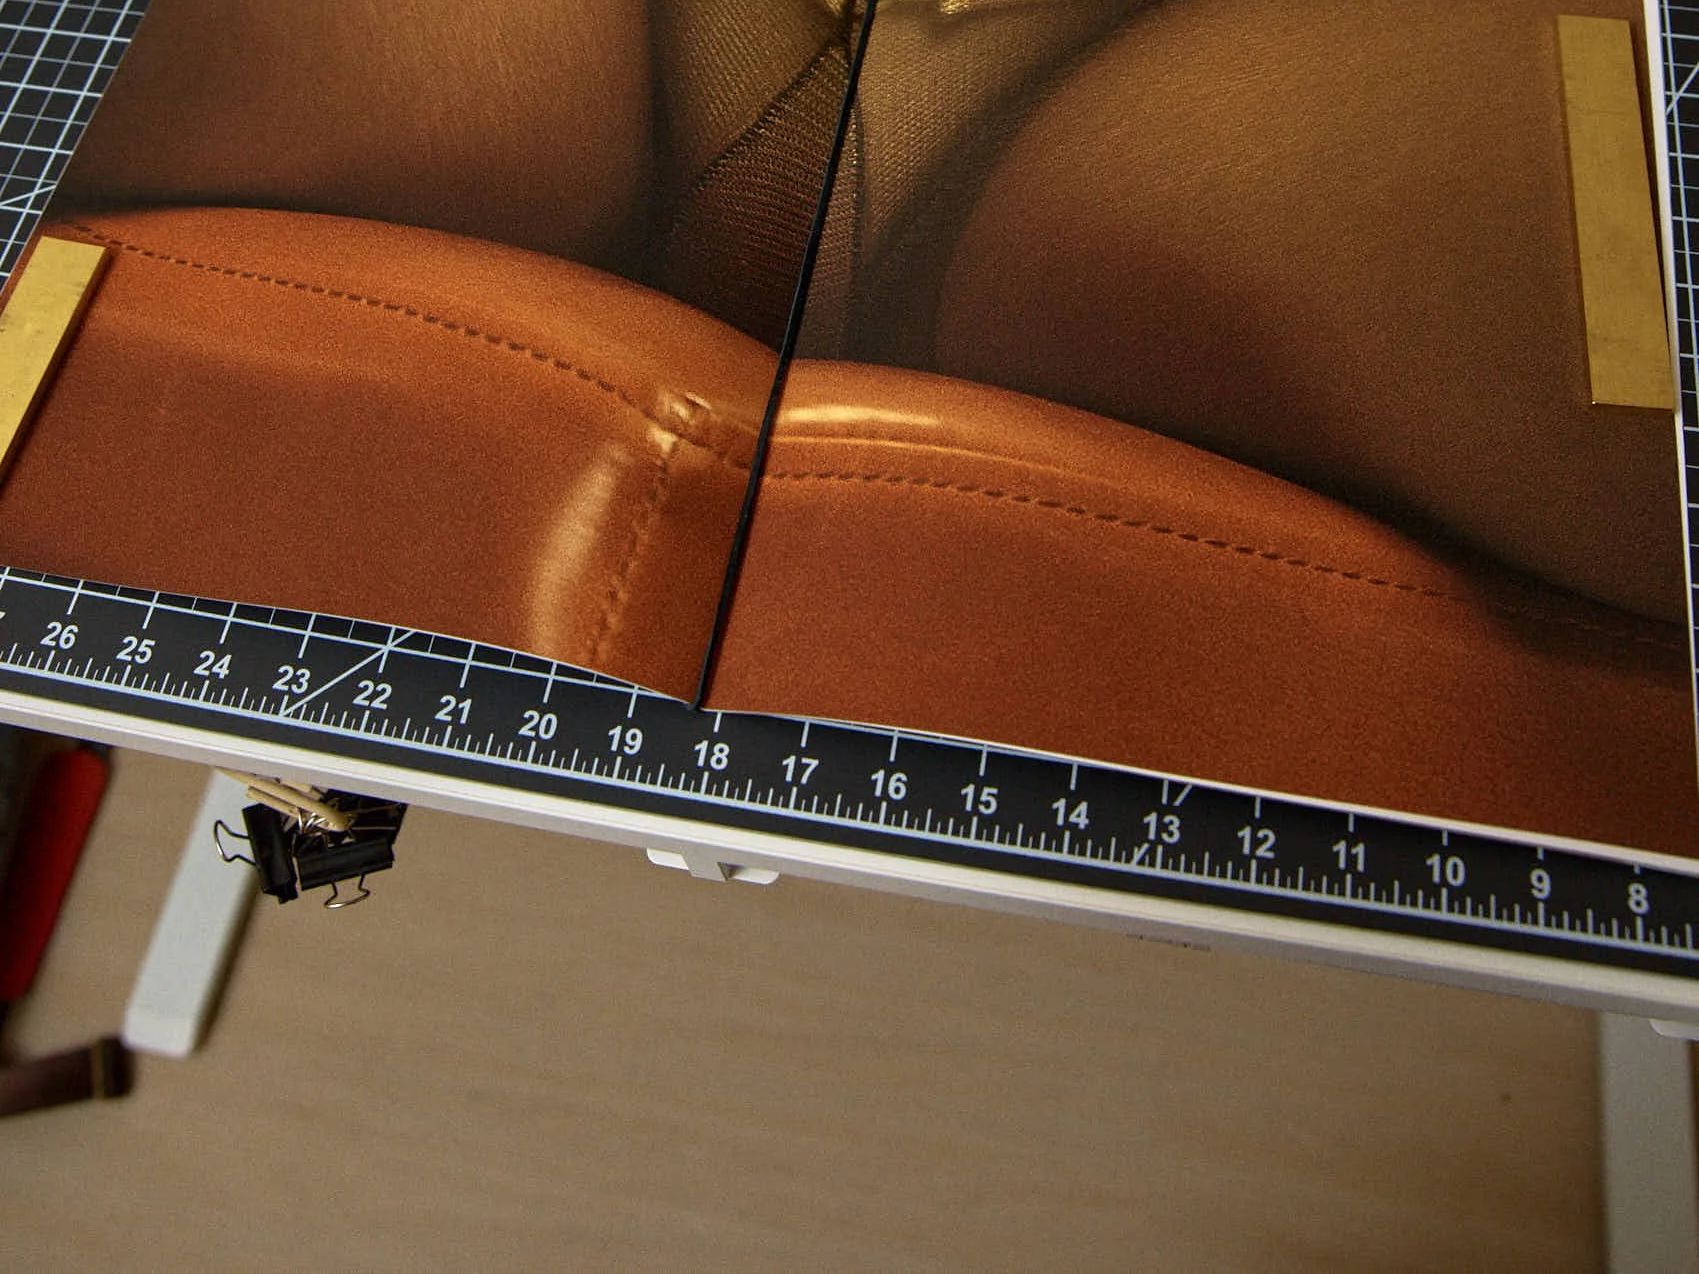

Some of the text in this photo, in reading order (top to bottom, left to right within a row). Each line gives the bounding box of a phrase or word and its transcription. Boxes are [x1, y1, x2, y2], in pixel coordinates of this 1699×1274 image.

[40, 622, 1649, 914] 26 25 24 23 22 21 20 19 18 17 16 15 14 13 12 11 10 9 8
